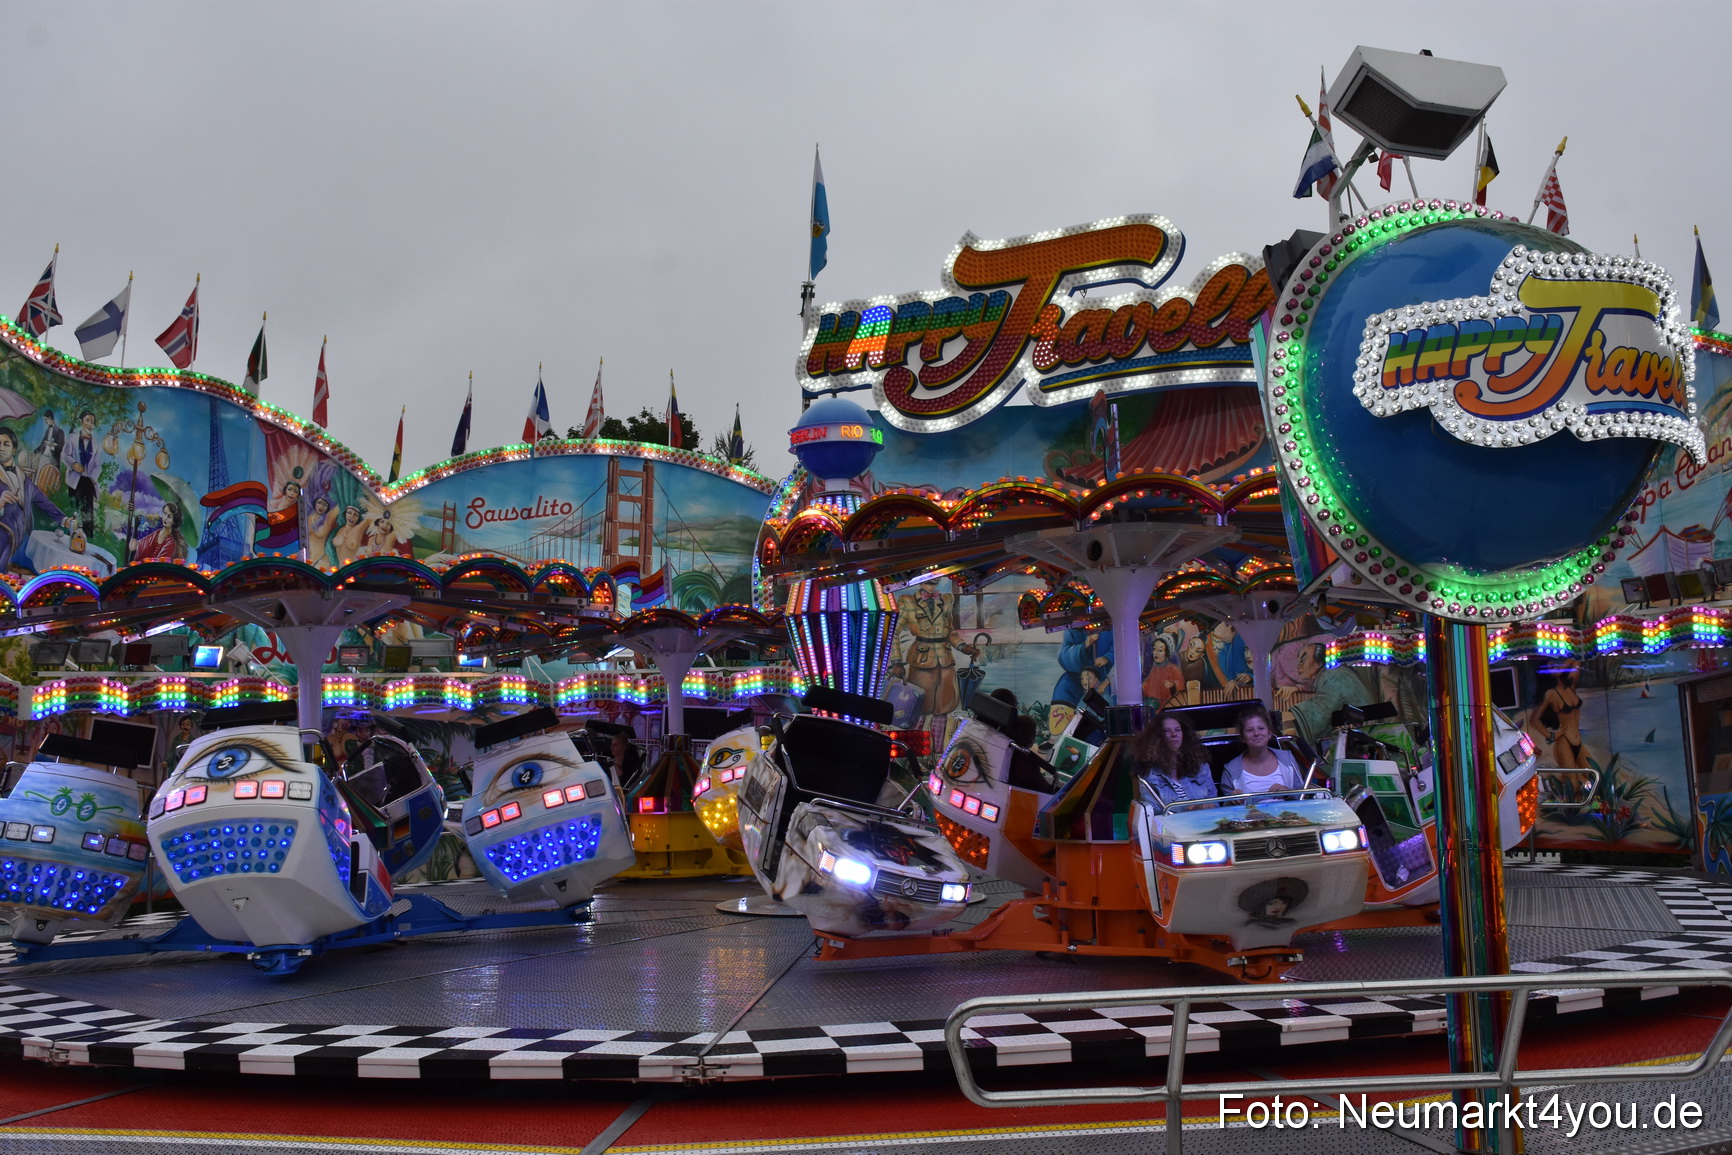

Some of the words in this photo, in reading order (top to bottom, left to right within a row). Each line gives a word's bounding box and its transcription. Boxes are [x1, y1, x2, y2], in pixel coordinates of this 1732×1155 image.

[806, 289, 1010, 388] HAPPY
[1381, 314, 1564, 393] HAPPY
[840, 425, 864, 438] RIO
[465, 495, 573, 530] Sausalito
[217, 756, 233, 769] 3
[521, 770, 531, 783] 4
